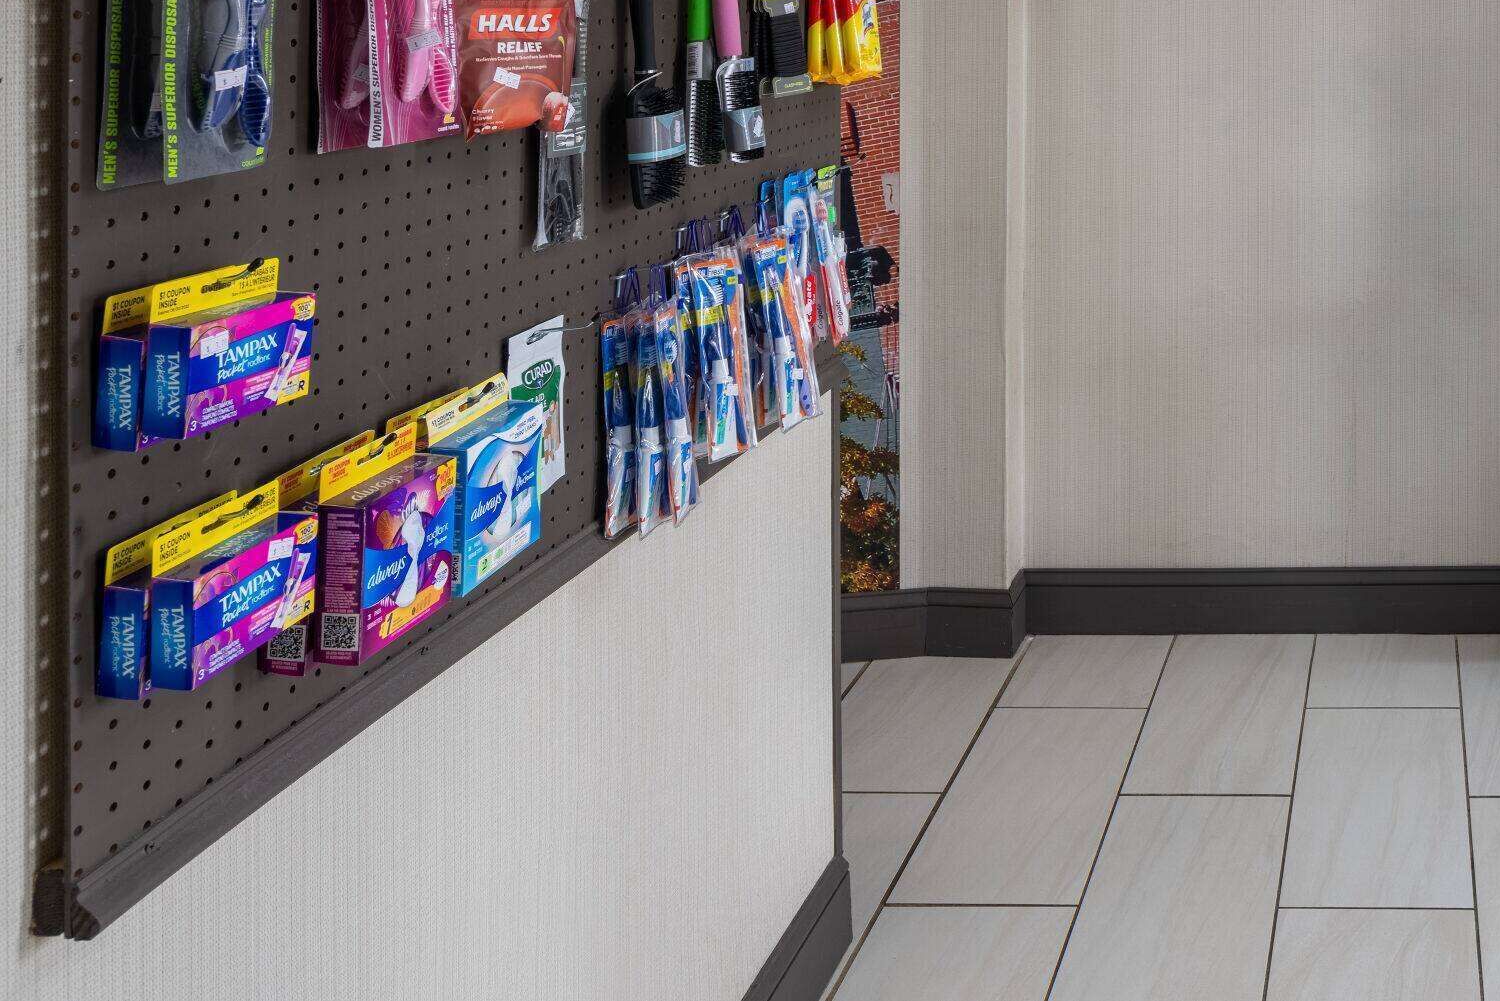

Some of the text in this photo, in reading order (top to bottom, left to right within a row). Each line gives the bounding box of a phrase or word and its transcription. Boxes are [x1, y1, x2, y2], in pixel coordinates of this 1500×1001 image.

[478, 13, 553, 33] HALLS
[370, 34, 383, 86] SUPERIOR
[497, 41, 543, 53] RELIEF
[107, 67, 120, 137] SUPERIOR
[167, 62, 177, 130] SUPERIOR
[369, 89, 383, 142] WOMEN'S
[103, 141, 117, 183] MEN'S
[168, 134, 178, 178] MEN'S
[121, 296, 145, 309] COUPON
[159, 285, 192, 300] $1 COUPON
[159, 298, 178, 310] INSIDE
[112, 308, 131, 320] INSIDE
[834, 300, 844, 326] Colgate
[216, 332, 278, 368] TAMPAX
[166, 351, 180, 417] TAMPAX
[524, 362, 552, 386] CURAD
[117, 365, 132, 430] TAMPAX
[190, 421, 197, 432] 3
[471, 493, 503, 523] always
[120, 540, 146, 558] COUPON
[159, 547, 179, 561] INSIDE
[166, 531, 192, 549] COUPON
[112, 556, 133, 570] INSIDE
[367, 555, 407, 590] always
[219, 562, 282, 613] TAMPAX
[122, 614, 135, 679] TAMPAX
[171, 605, 187, 668] TAMPAX
[198, 669, 204, 680] 3
